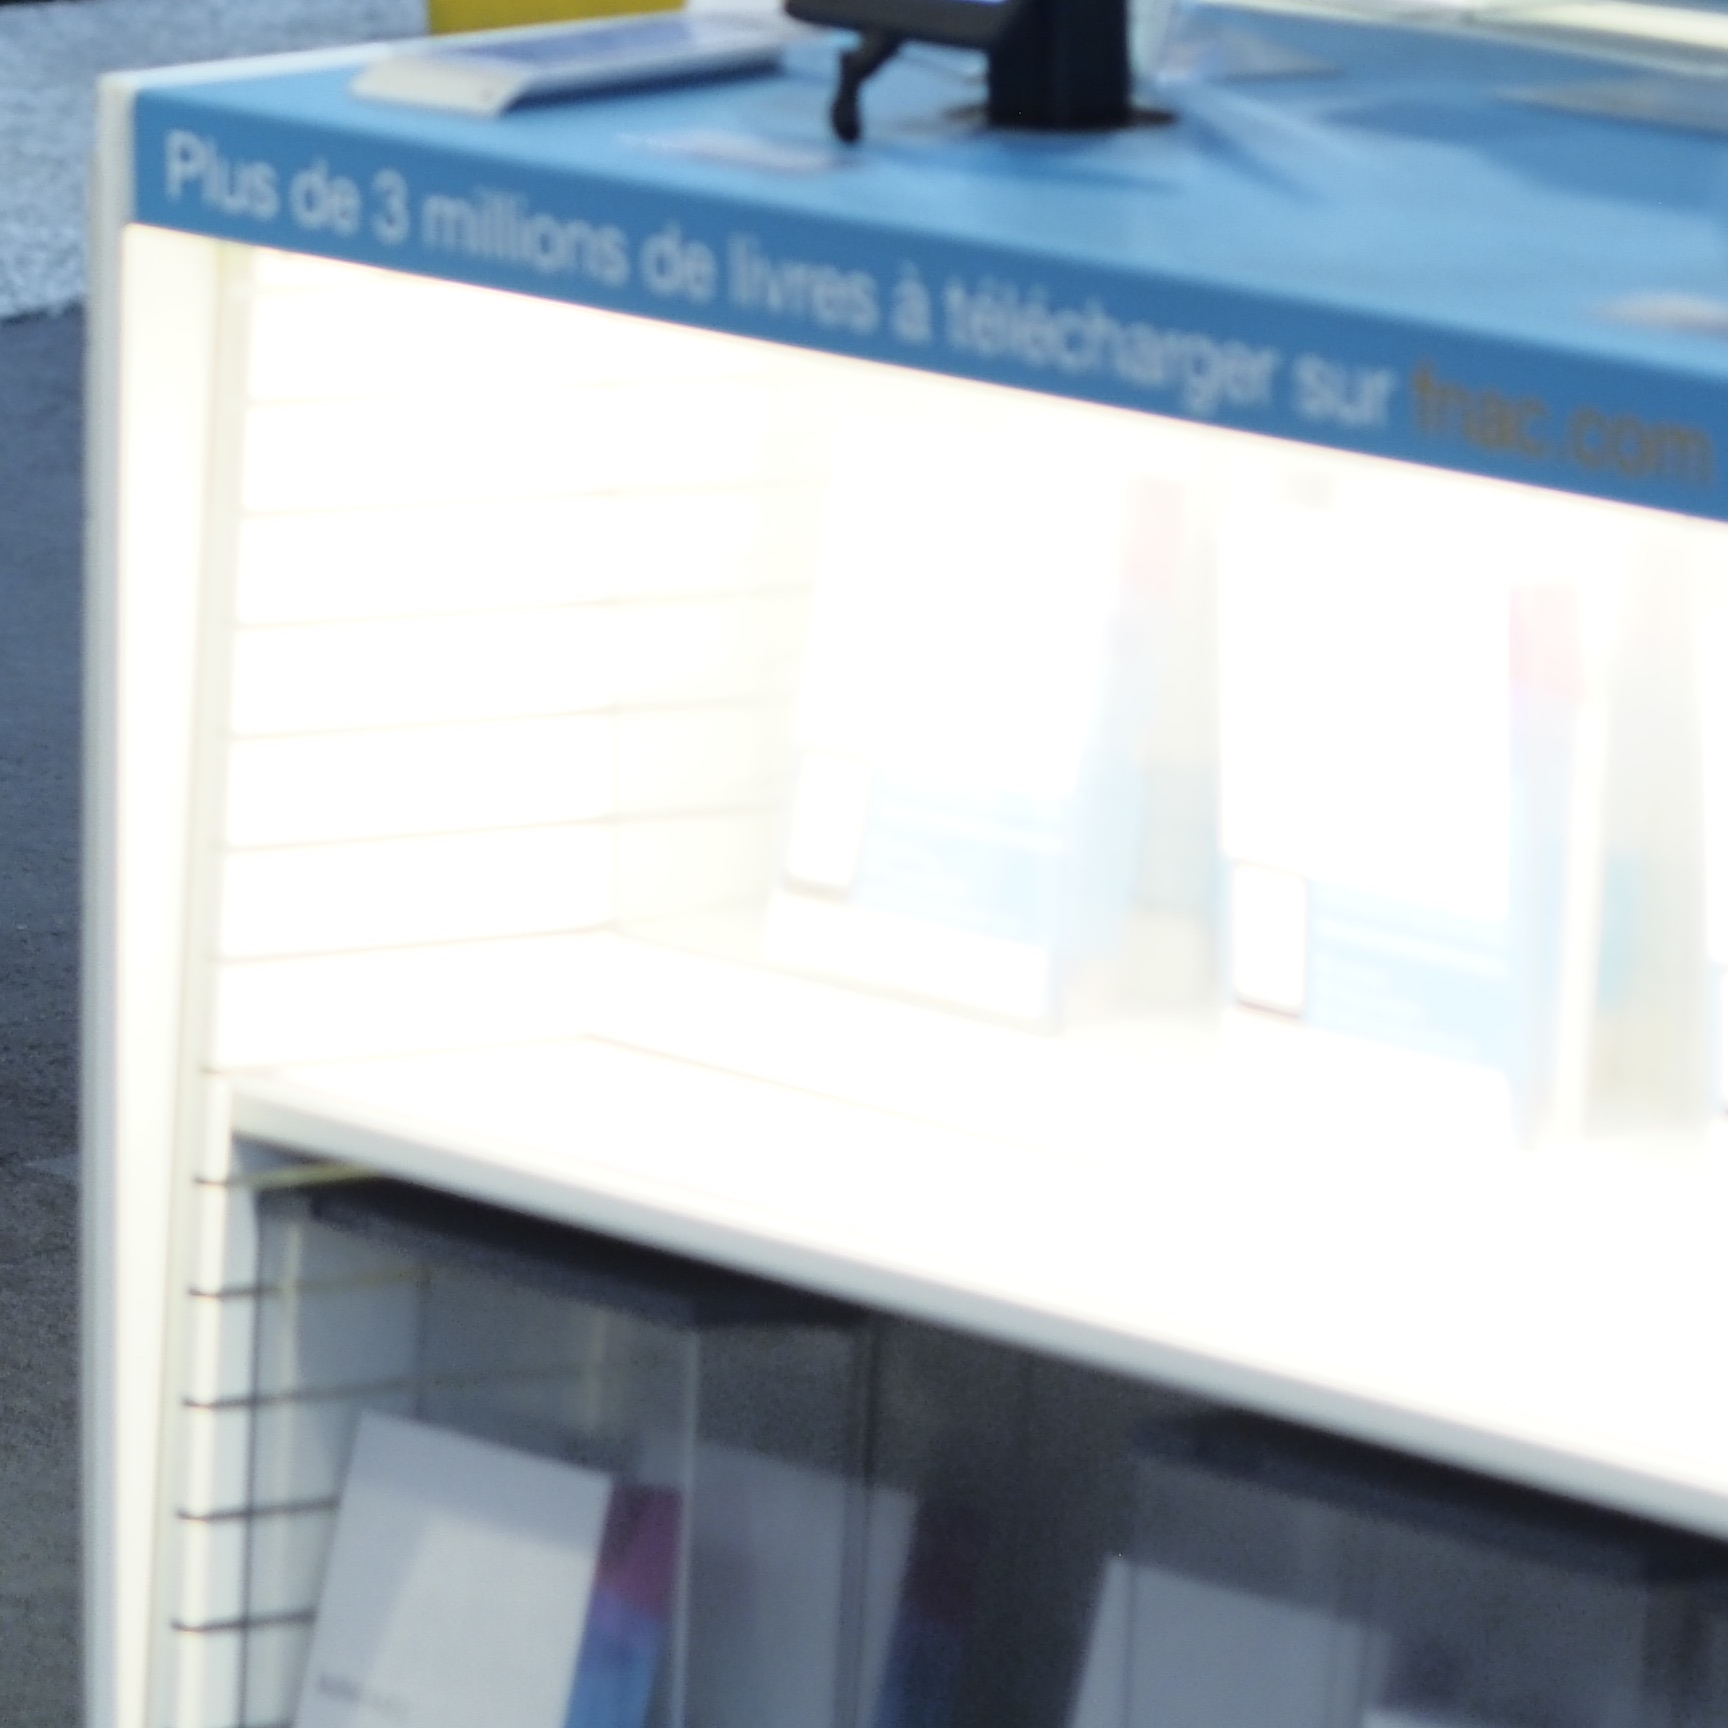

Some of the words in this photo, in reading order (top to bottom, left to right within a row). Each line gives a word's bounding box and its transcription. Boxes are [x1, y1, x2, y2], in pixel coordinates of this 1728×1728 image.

[163, 130, 282, 220] Plus
[290, 157, 362, 237] de
[371, 168, 410, 249] 3
[422, 180, 630, 290] millions
[642, 221, 716, 305] de
[727, 230, 879, 334] livres
[891, 260, 932, 344] à
[944, 271, 1281, 422] télécharger
[1292, 352, 1397, 430] sur
